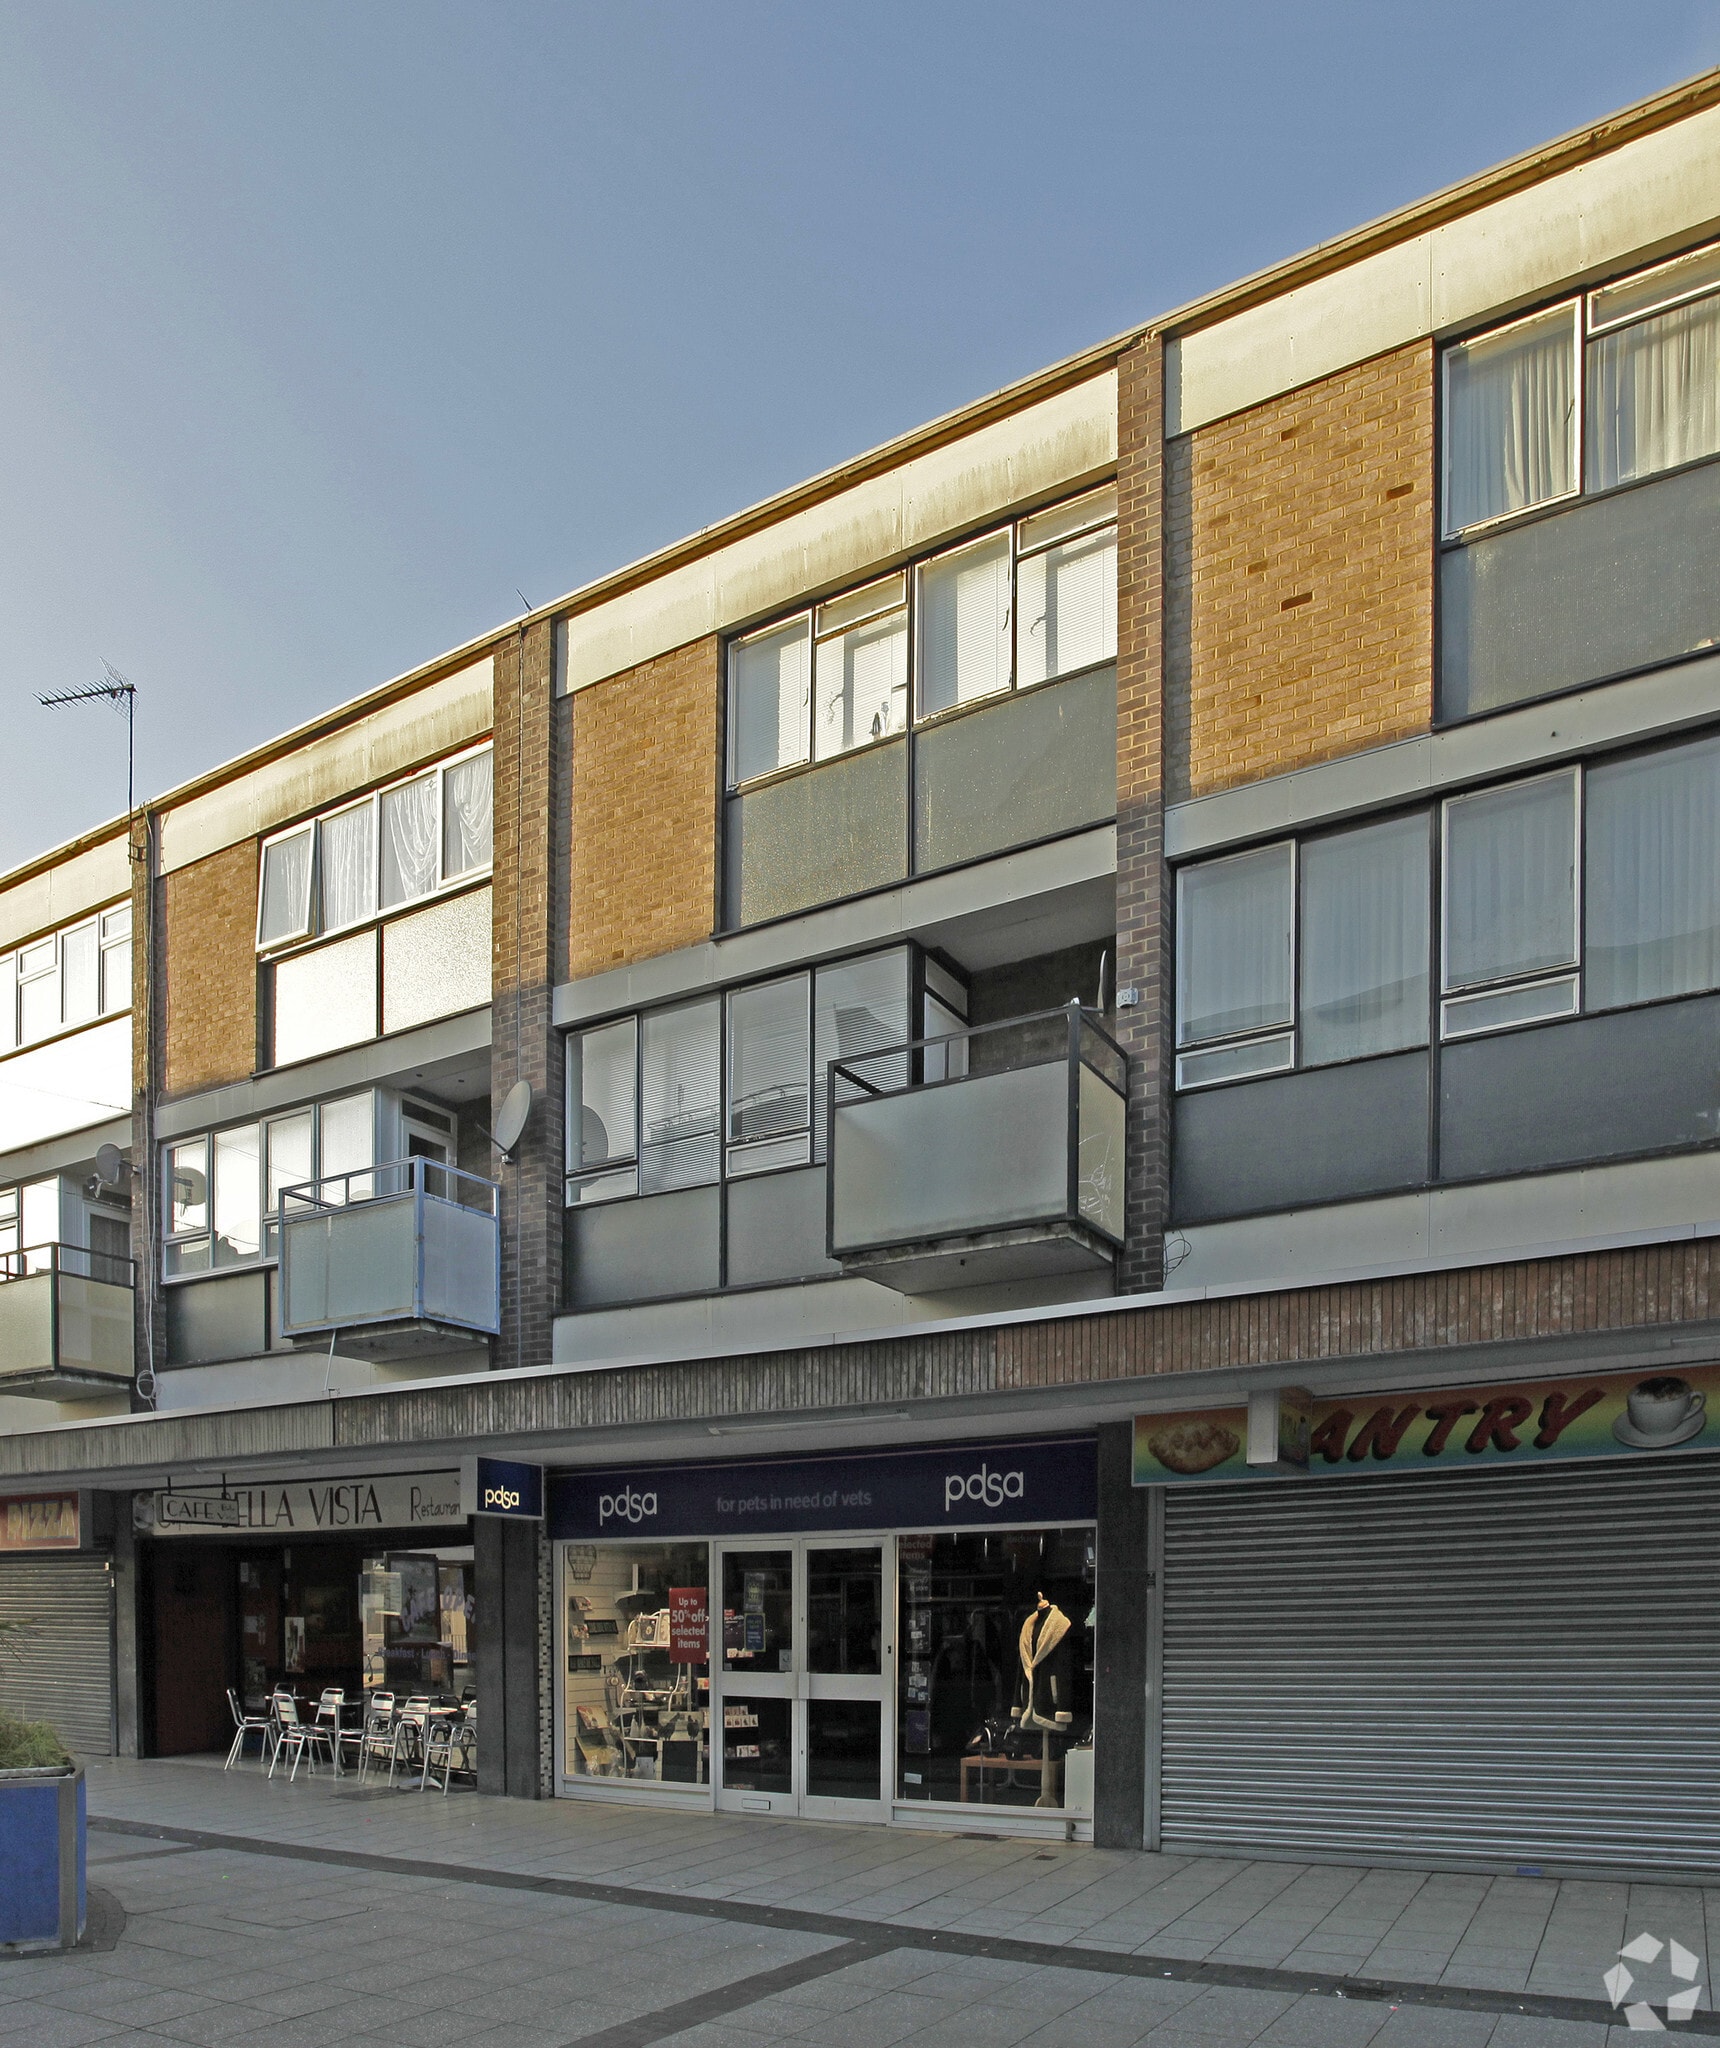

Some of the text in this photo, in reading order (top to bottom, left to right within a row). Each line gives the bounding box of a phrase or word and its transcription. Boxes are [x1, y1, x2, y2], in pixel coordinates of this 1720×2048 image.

[1310, 1388, 1607, 1462] ANTRY
[485, 1485, 519, 1509] pdsa
[945, 1463, 1024, 1512] pdsa
[166, 1500, 214, 1518] CAFE
[308, 1484, 382, 1525] VISTA
[410, 1486, 460, 1521] Restauran
[599, 1484, 657, 1526] pdsa
[716, 1489, 872, 1515] for pets in need of vets
[7, 1498, 76, 1541] PIZZA
[678, 1597, 698, 1608] Up to
[671, 1608, 705, 1623] 50% off
[671, 1624, 705, 1636] selected
[452, 1649, 477, 1661] Dinne
[677, 1637, 701, 1649] items
